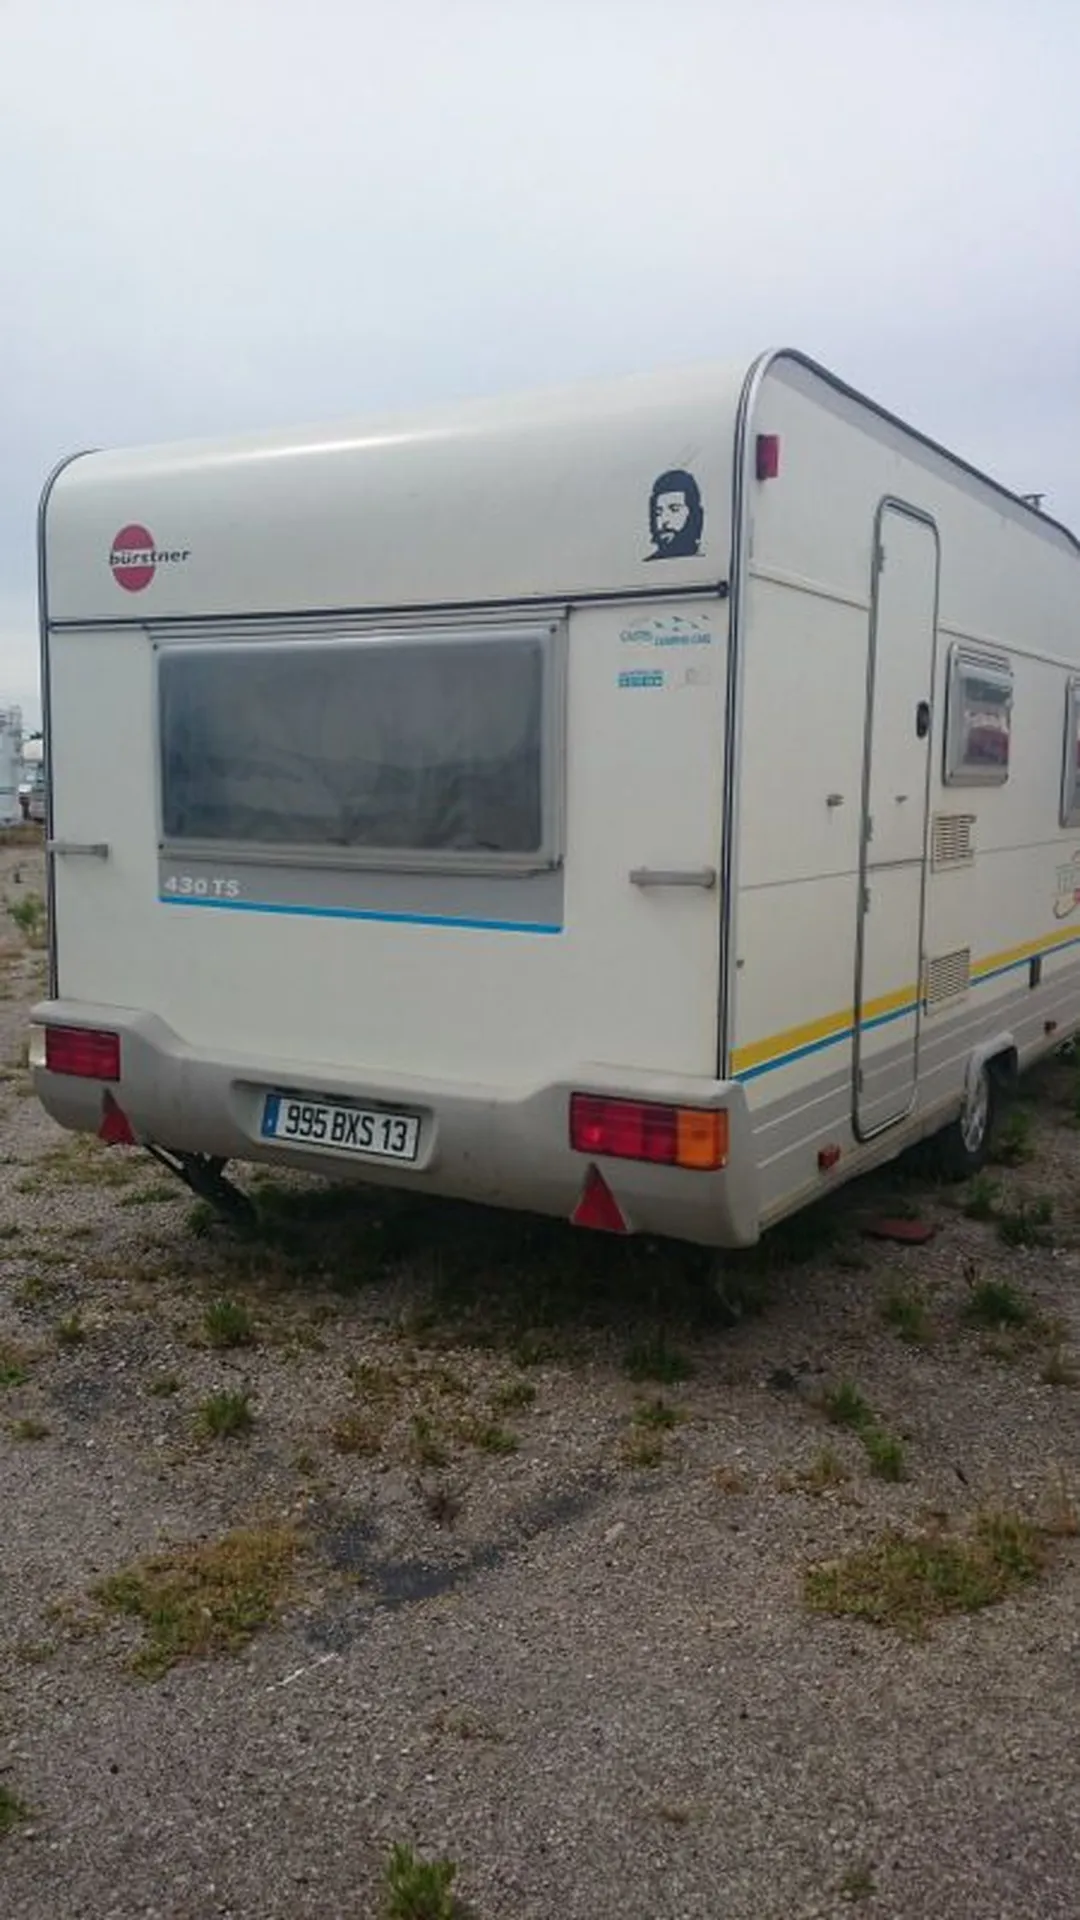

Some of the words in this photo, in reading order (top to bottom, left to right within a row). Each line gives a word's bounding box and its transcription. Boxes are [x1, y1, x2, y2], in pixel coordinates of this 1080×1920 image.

[164, 876, 207, 895] 430
[212, 879, 239, 897] TS
[285, 1105, 327, 1139] 995
[331, 1111, 375, 1147] BXS
[382, 1119, 408, 1152] 13
